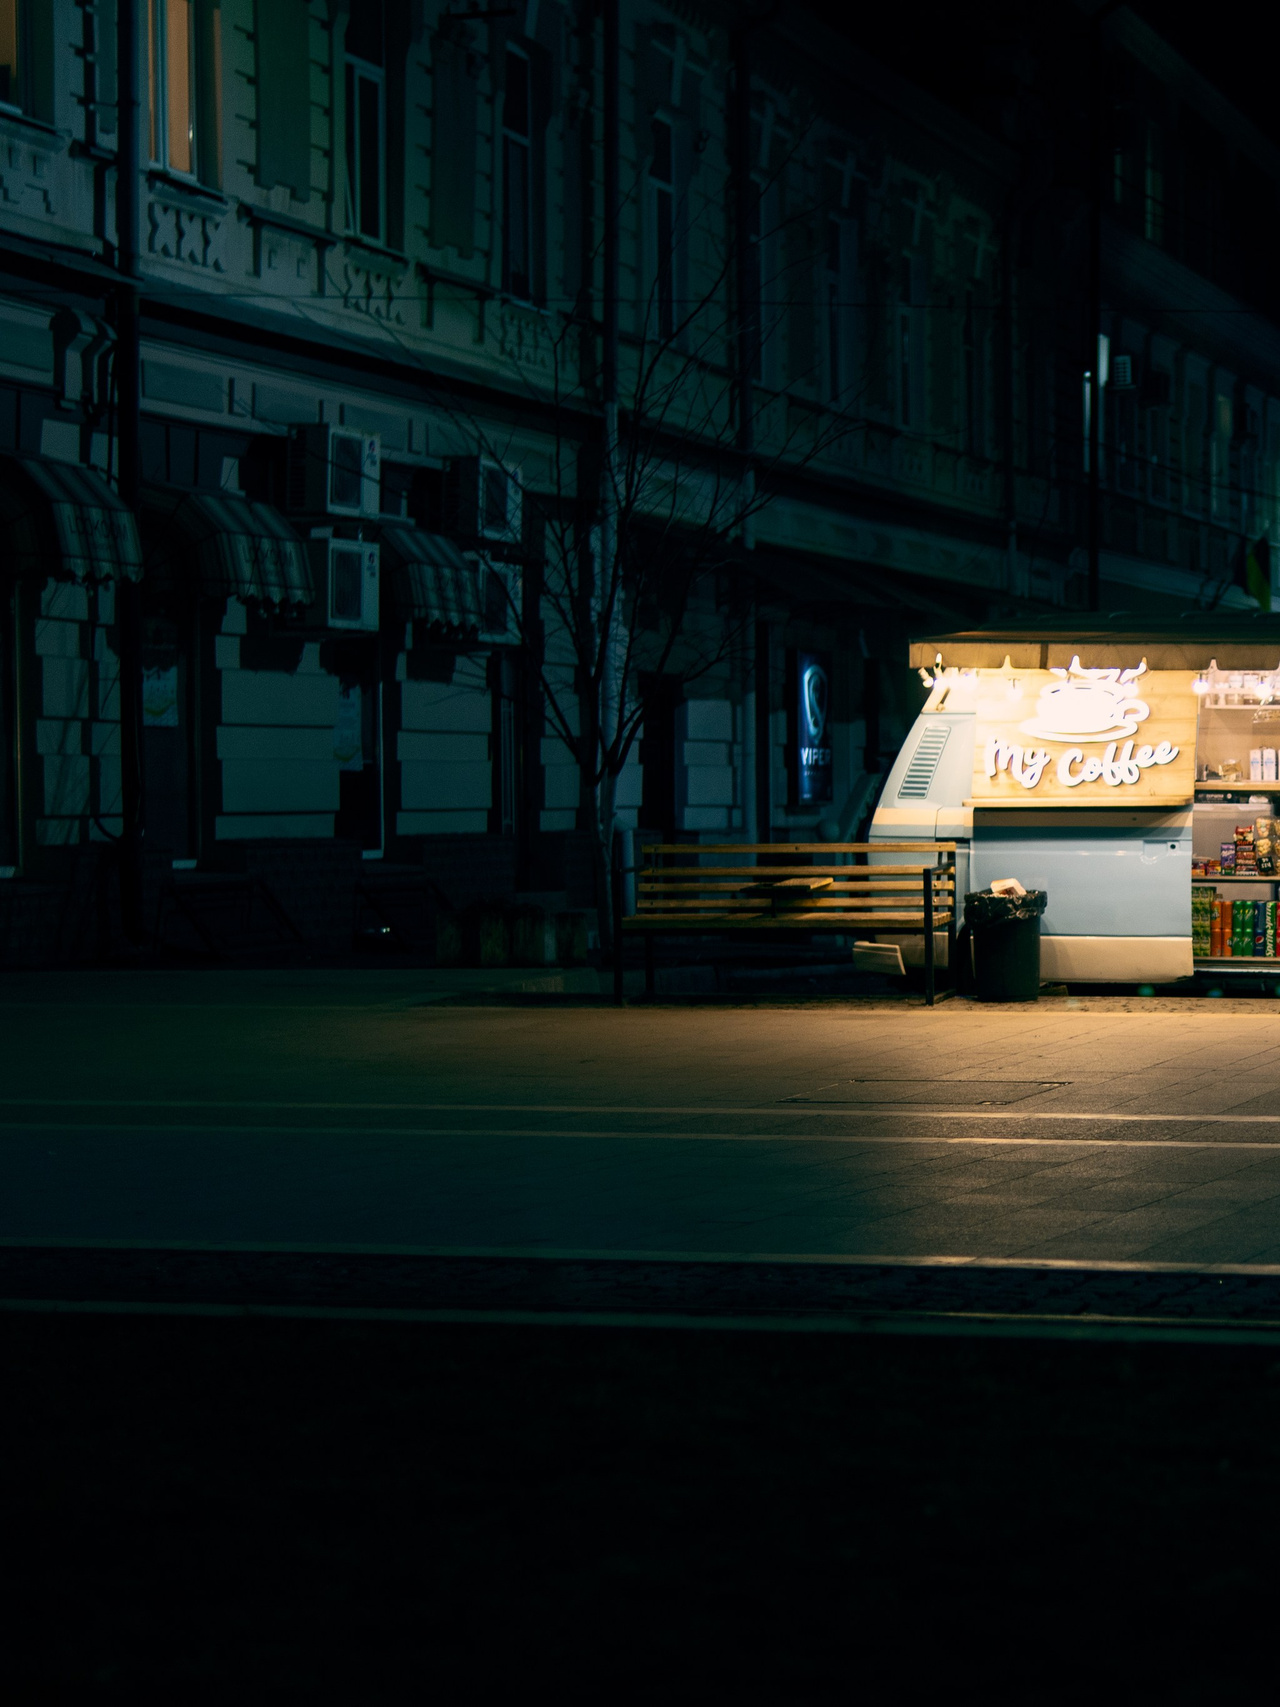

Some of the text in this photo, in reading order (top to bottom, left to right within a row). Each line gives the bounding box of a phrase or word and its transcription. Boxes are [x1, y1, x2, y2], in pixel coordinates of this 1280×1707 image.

[800, 746, 831, 767] VIPER
[986, 739, 1179, 789] My Coffee
[1265, 929, 1276, 957] Sprite
